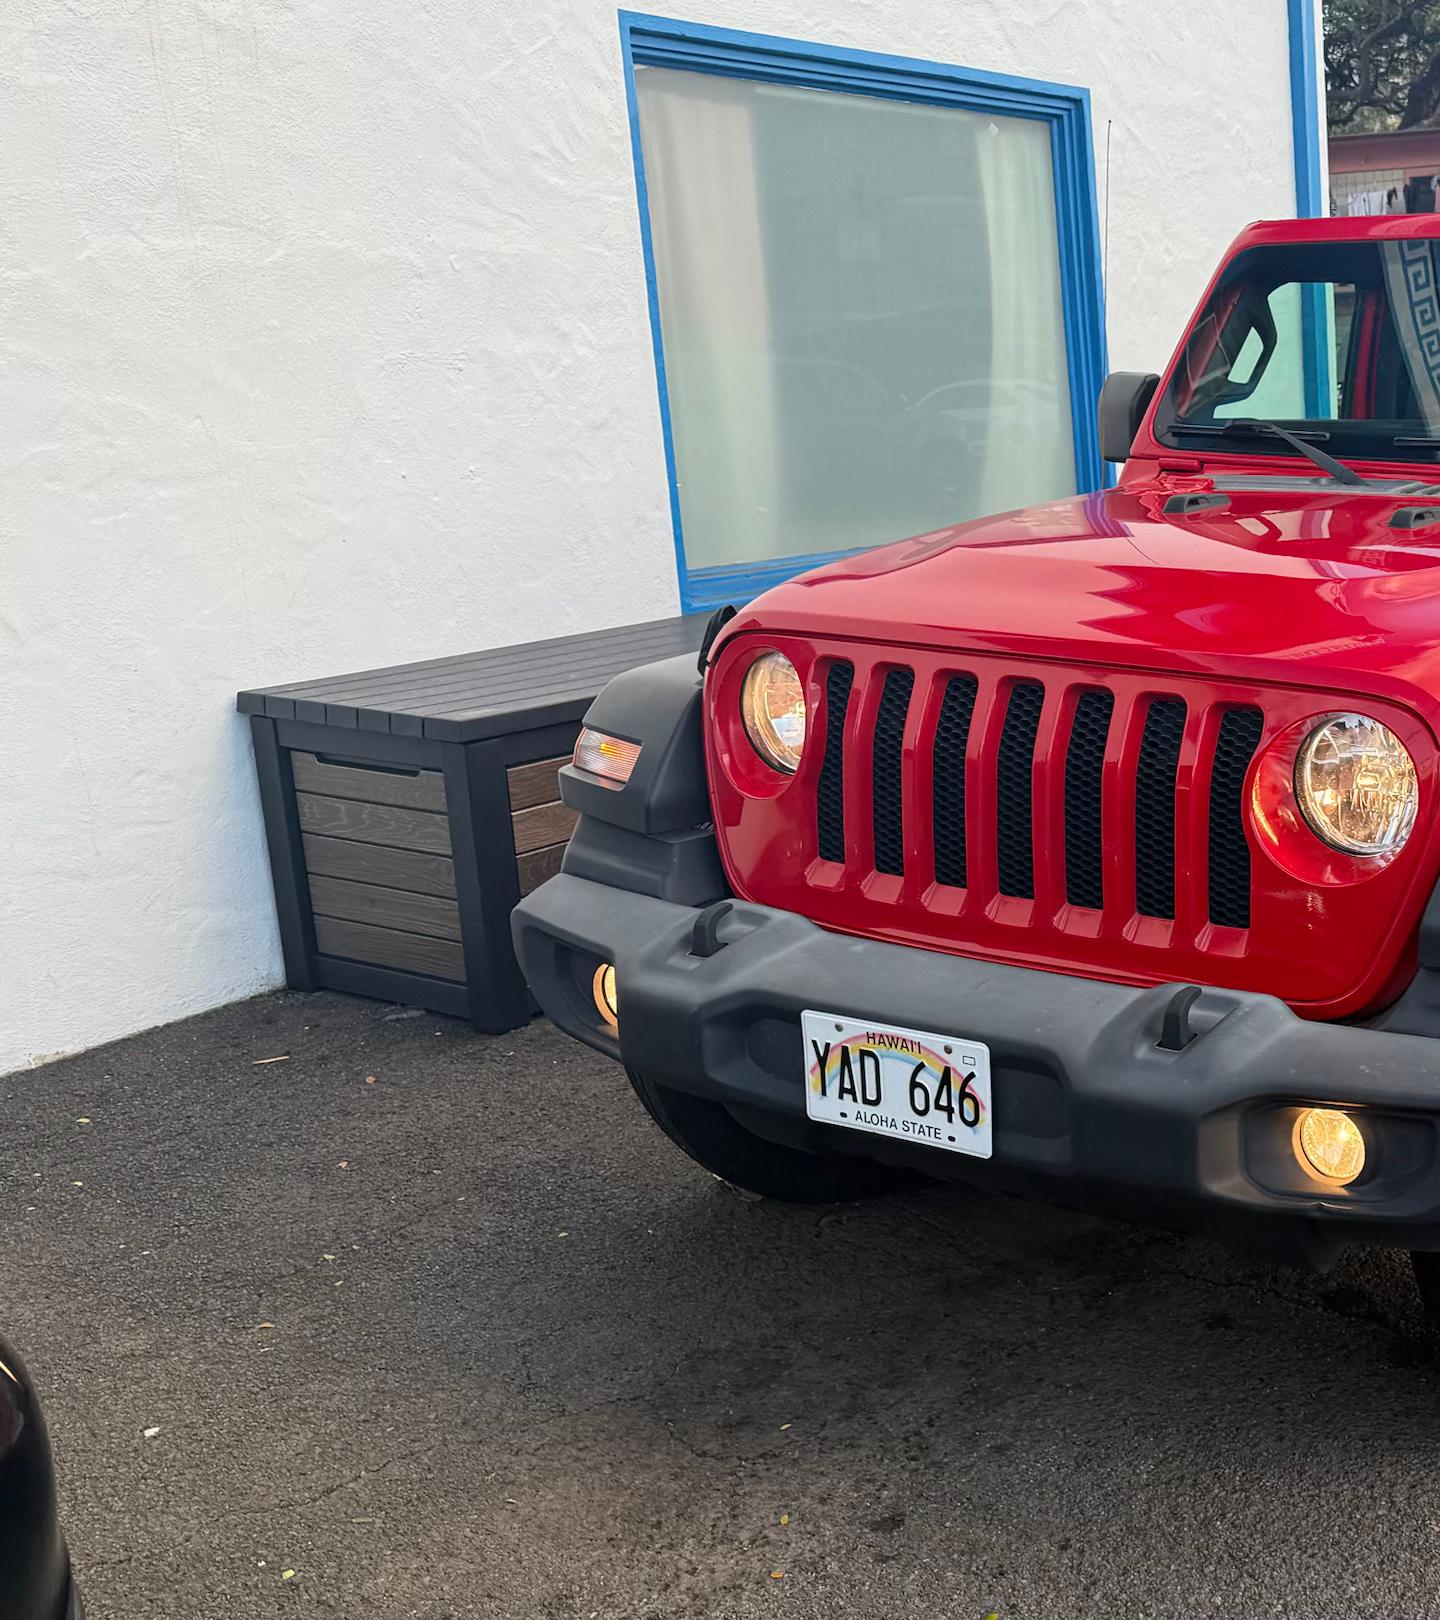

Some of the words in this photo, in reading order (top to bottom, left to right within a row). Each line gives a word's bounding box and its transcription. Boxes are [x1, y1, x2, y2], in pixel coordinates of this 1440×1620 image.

[811, 1039, 882, 1107] YAD
[908, 1061, 980, 1128] 646
[855, 1110, 898, 1130] ALOHA
[902, 1120, 942, 1140] STATE
